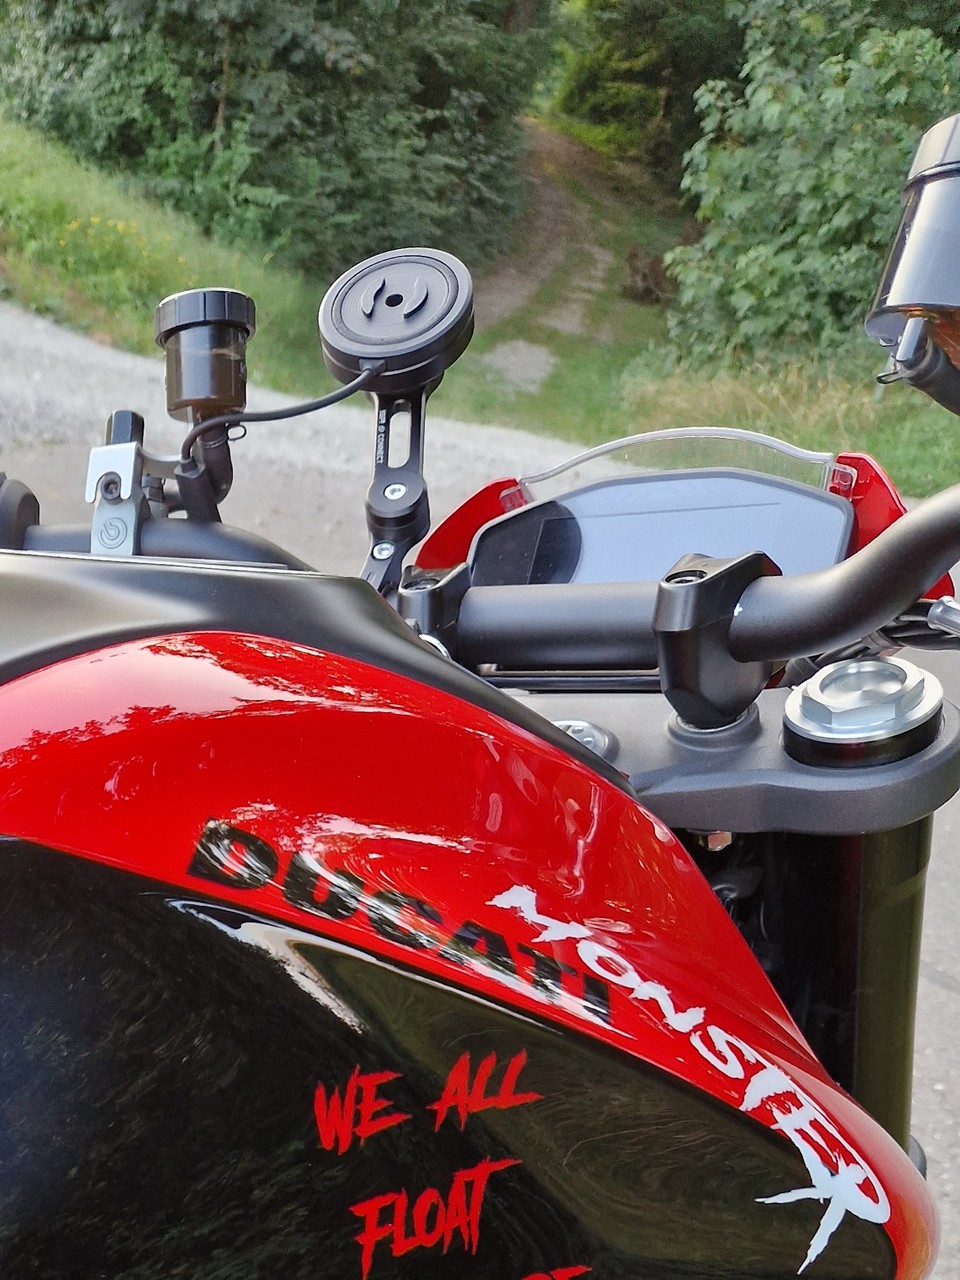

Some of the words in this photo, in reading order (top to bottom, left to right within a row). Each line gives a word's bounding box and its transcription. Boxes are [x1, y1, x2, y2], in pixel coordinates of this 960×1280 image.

[186, 817, 611, 1026] DUCATI
[313, 1064, 412, 1155] WE
[431, 1049, 543, 1131] ALL
[484, 884, 890, 1275] MONSTER
